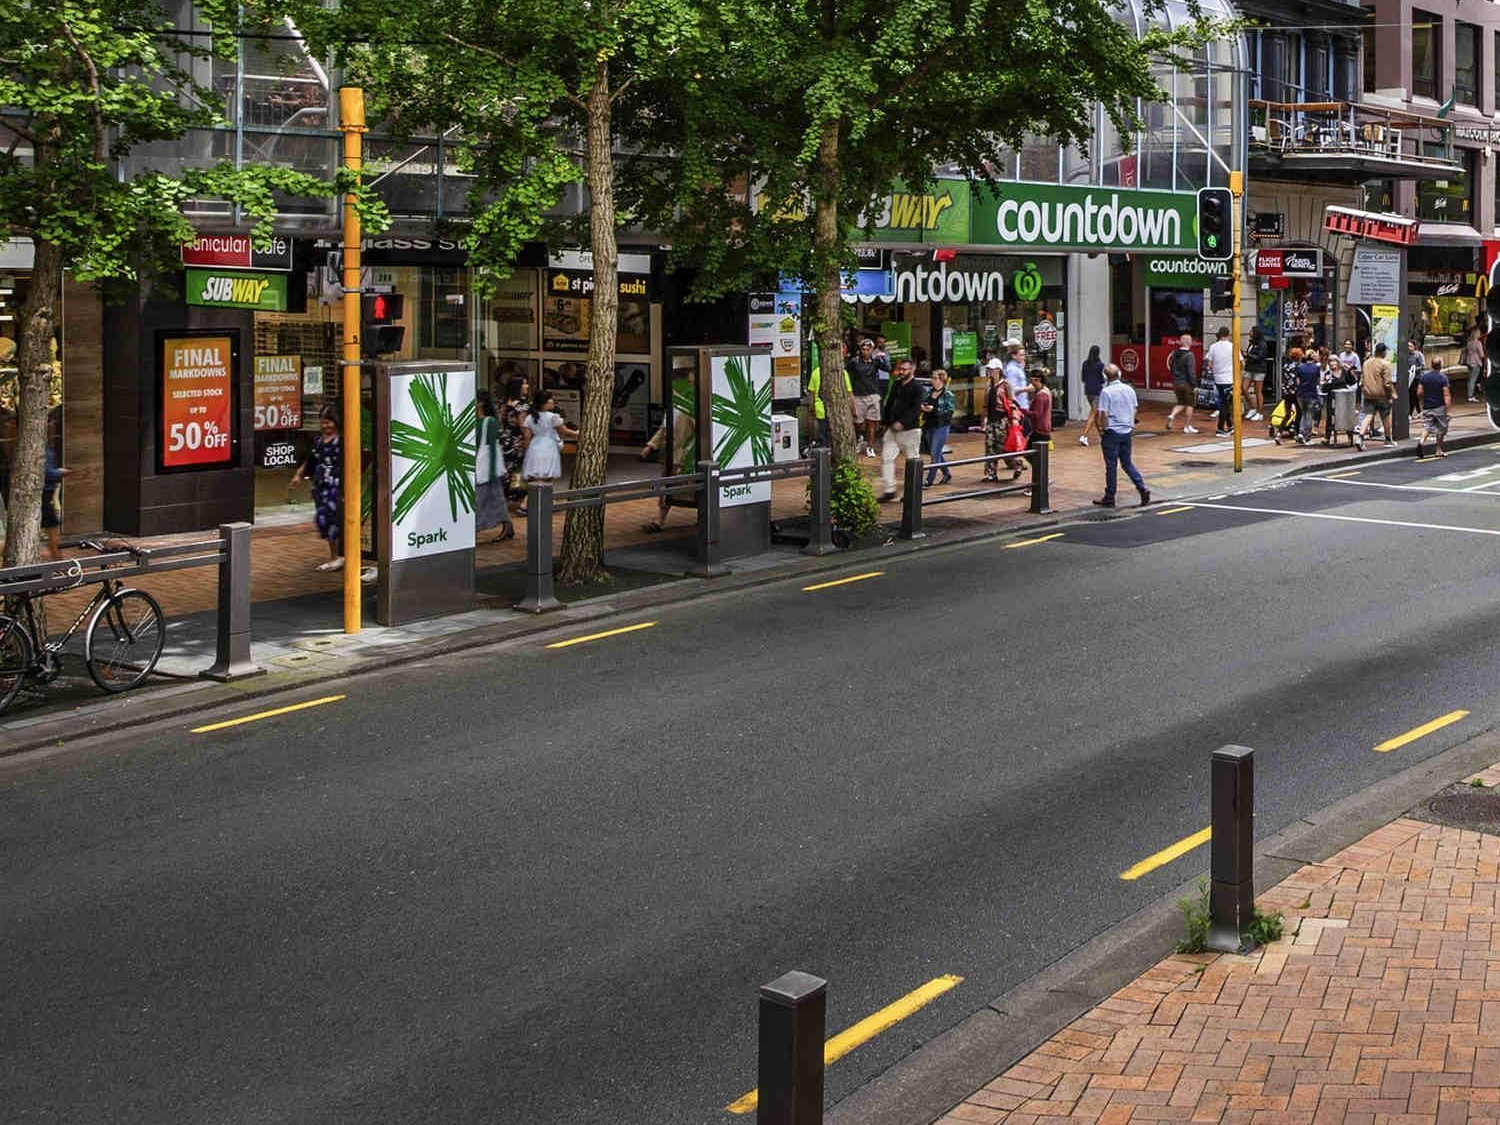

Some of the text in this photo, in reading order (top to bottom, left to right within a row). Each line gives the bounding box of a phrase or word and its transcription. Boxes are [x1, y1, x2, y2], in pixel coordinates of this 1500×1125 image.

[997, 194, 1181, 246] countdown
[188, 236, 247, 253] unicular
[1150, 259, 1227, 275] countdown
[202, 277, 269, 303] SUBWAY
[619, 279, 646, 295] sushi
[841, 261, 1004, 304] ntdown
[174, 348, 223, 367] FINAL
[258, 357, 295, 373] FINAL
[169, 367, 226, 379] MARKDOWNS
[201, 388, 224, 397] STOCK
[254, 405, 279, 428] 50
[281, 414, 299, 427] OFF
[169, 420, 218, 452] 50 %
[204, 433, 228, 449] OFF
[265, 445, 295, 457] SHOP
[263, 456, 297, 466] LOCAL
[722, 483, 752, 499] Spark
[407, 528, 447, 548] Spark
